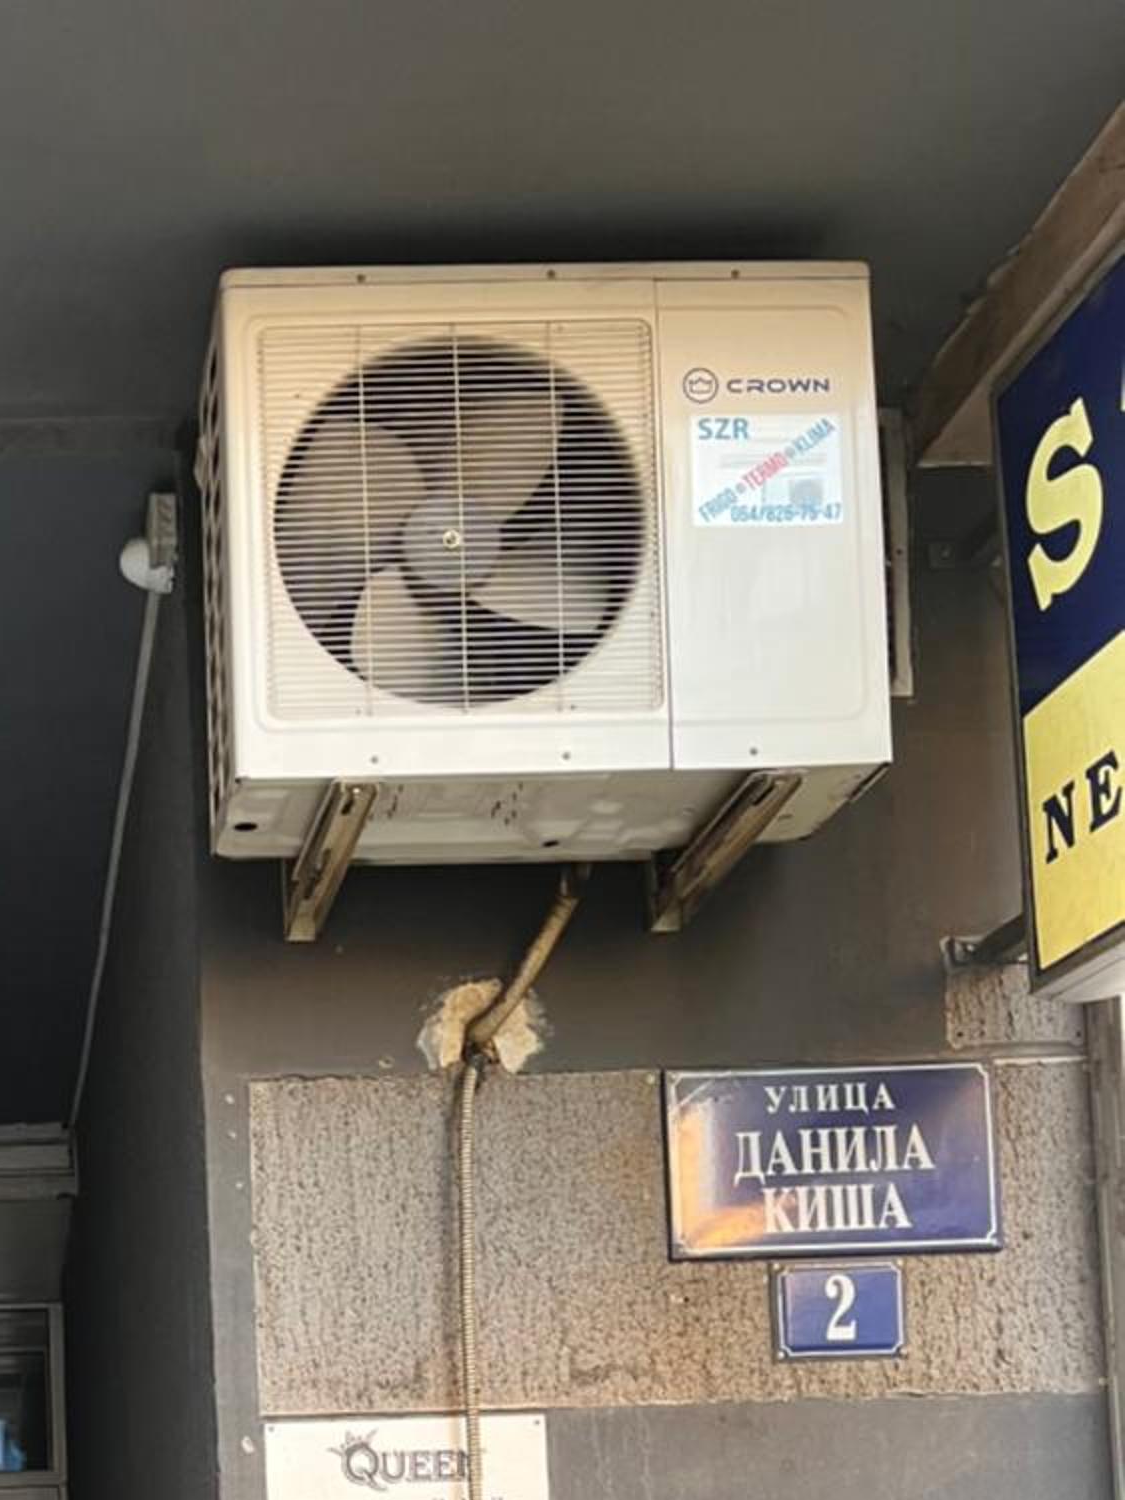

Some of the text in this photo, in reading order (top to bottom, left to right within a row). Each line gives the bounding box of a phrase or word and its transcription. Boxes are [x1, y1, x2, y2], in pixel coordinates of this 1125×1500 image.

[726, 378, 830, 394] CROWN
[697, 417, 750, 440] SZR
[764, 1082, 896, 1114] УЛИЦА
[733, 1121, 936, 1187] ДАНИЛА
[762, 1182, 913, 1234] КИША
[825, 1274, 858, 1341] 2
